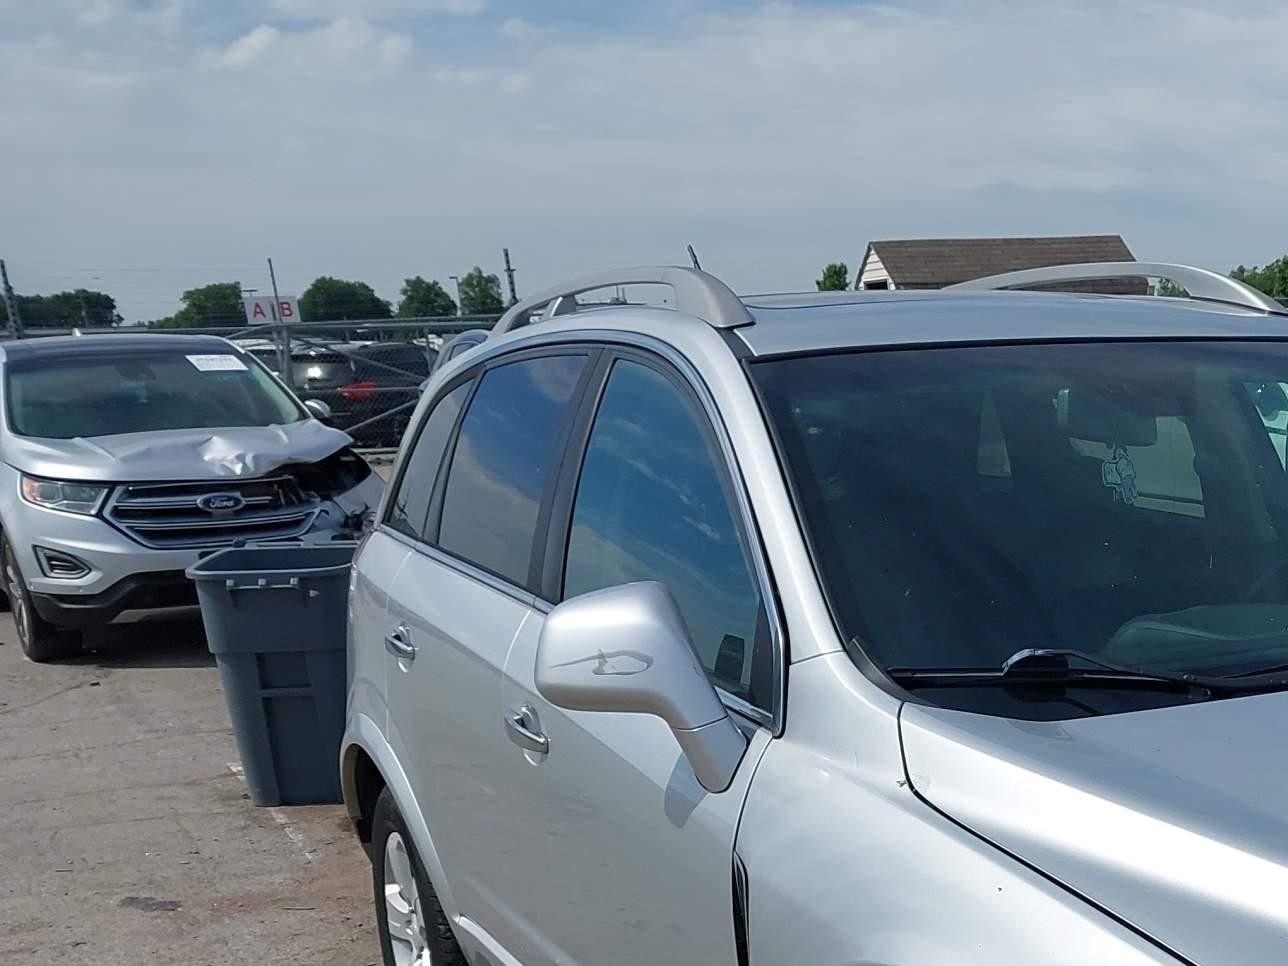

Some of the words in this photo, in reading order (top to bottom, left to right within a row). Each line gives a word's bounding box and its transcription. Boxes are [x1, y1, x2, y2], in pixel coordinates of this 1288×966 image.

[253, 302, 266, 318] A
[280, 301, 293, 317] B
[209, 497, 235, 508] Ford
